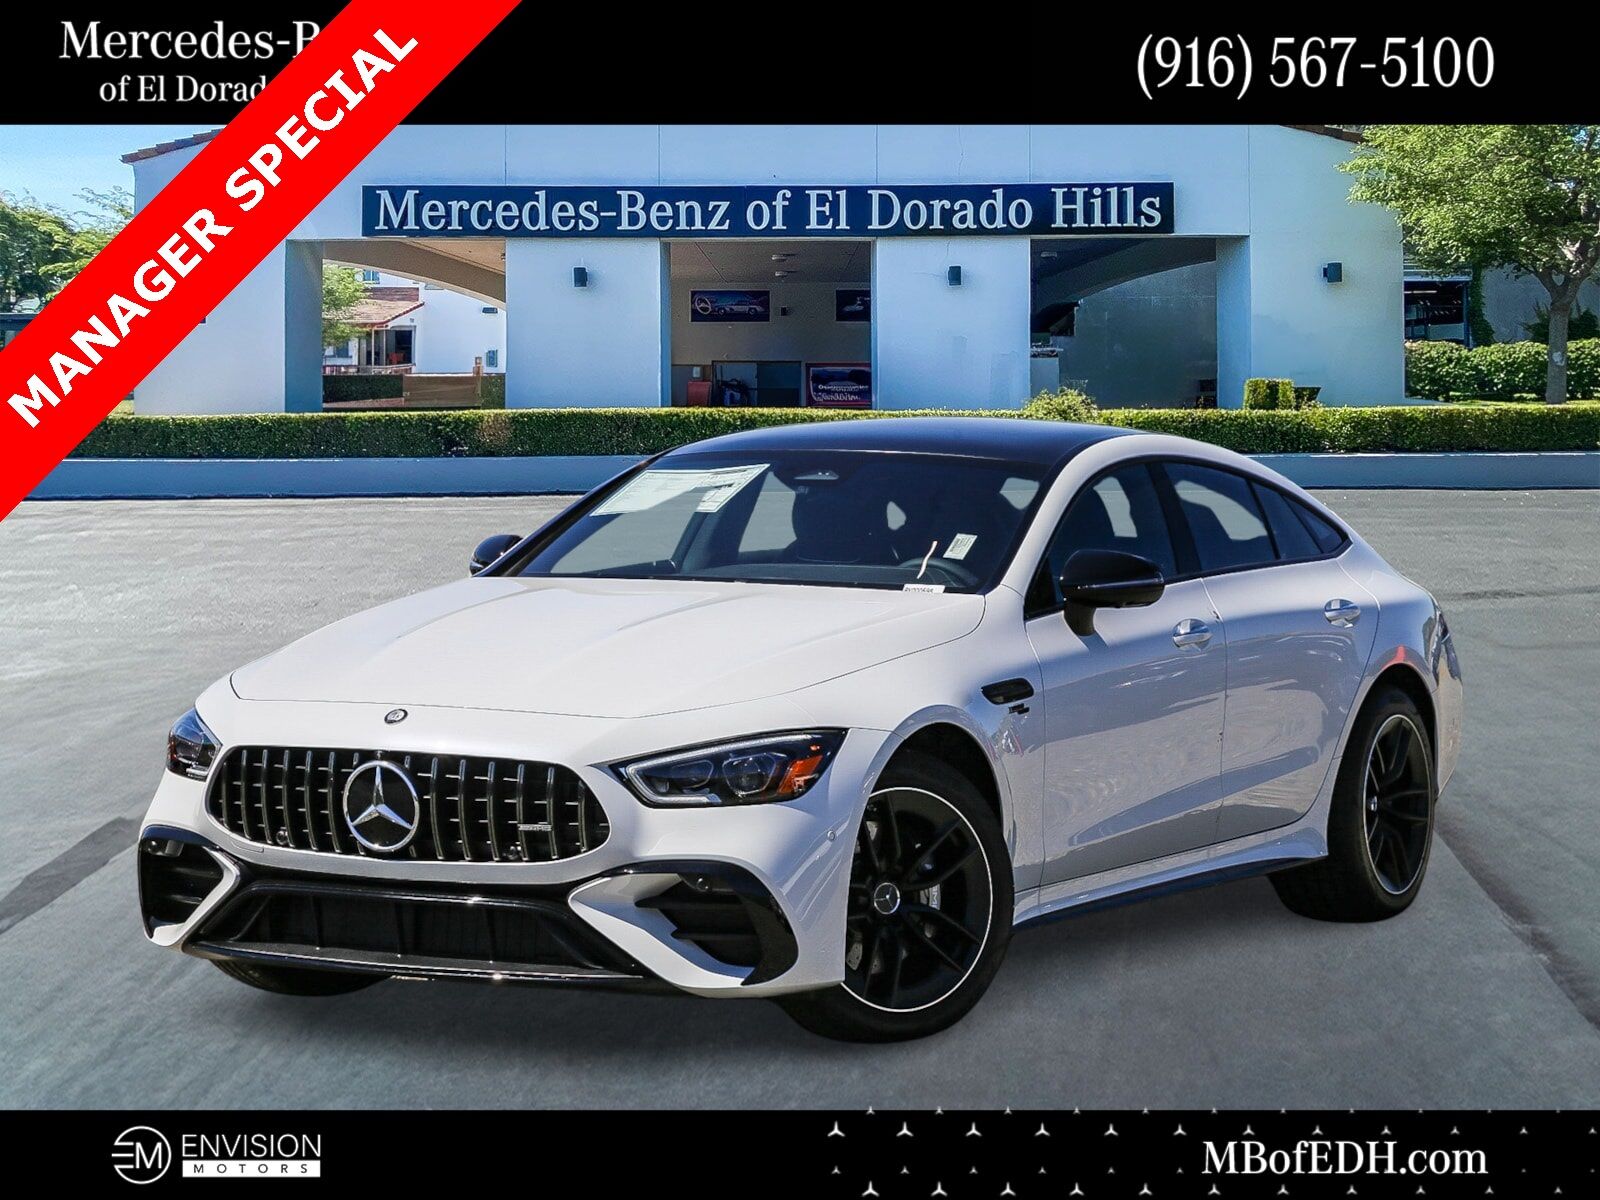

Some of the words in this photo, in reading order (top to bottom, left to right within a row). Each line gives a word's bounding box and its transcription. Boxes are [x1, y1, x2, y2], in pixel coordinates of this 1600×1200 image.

[374, 189, 731, 231] Mercedes-Benz
[745, 189, 792, 231] of
[805, 189, 851, 230] El
[867, 189, 1033, 230] Dorado
[1051, 186, 1162, 229] Hills
